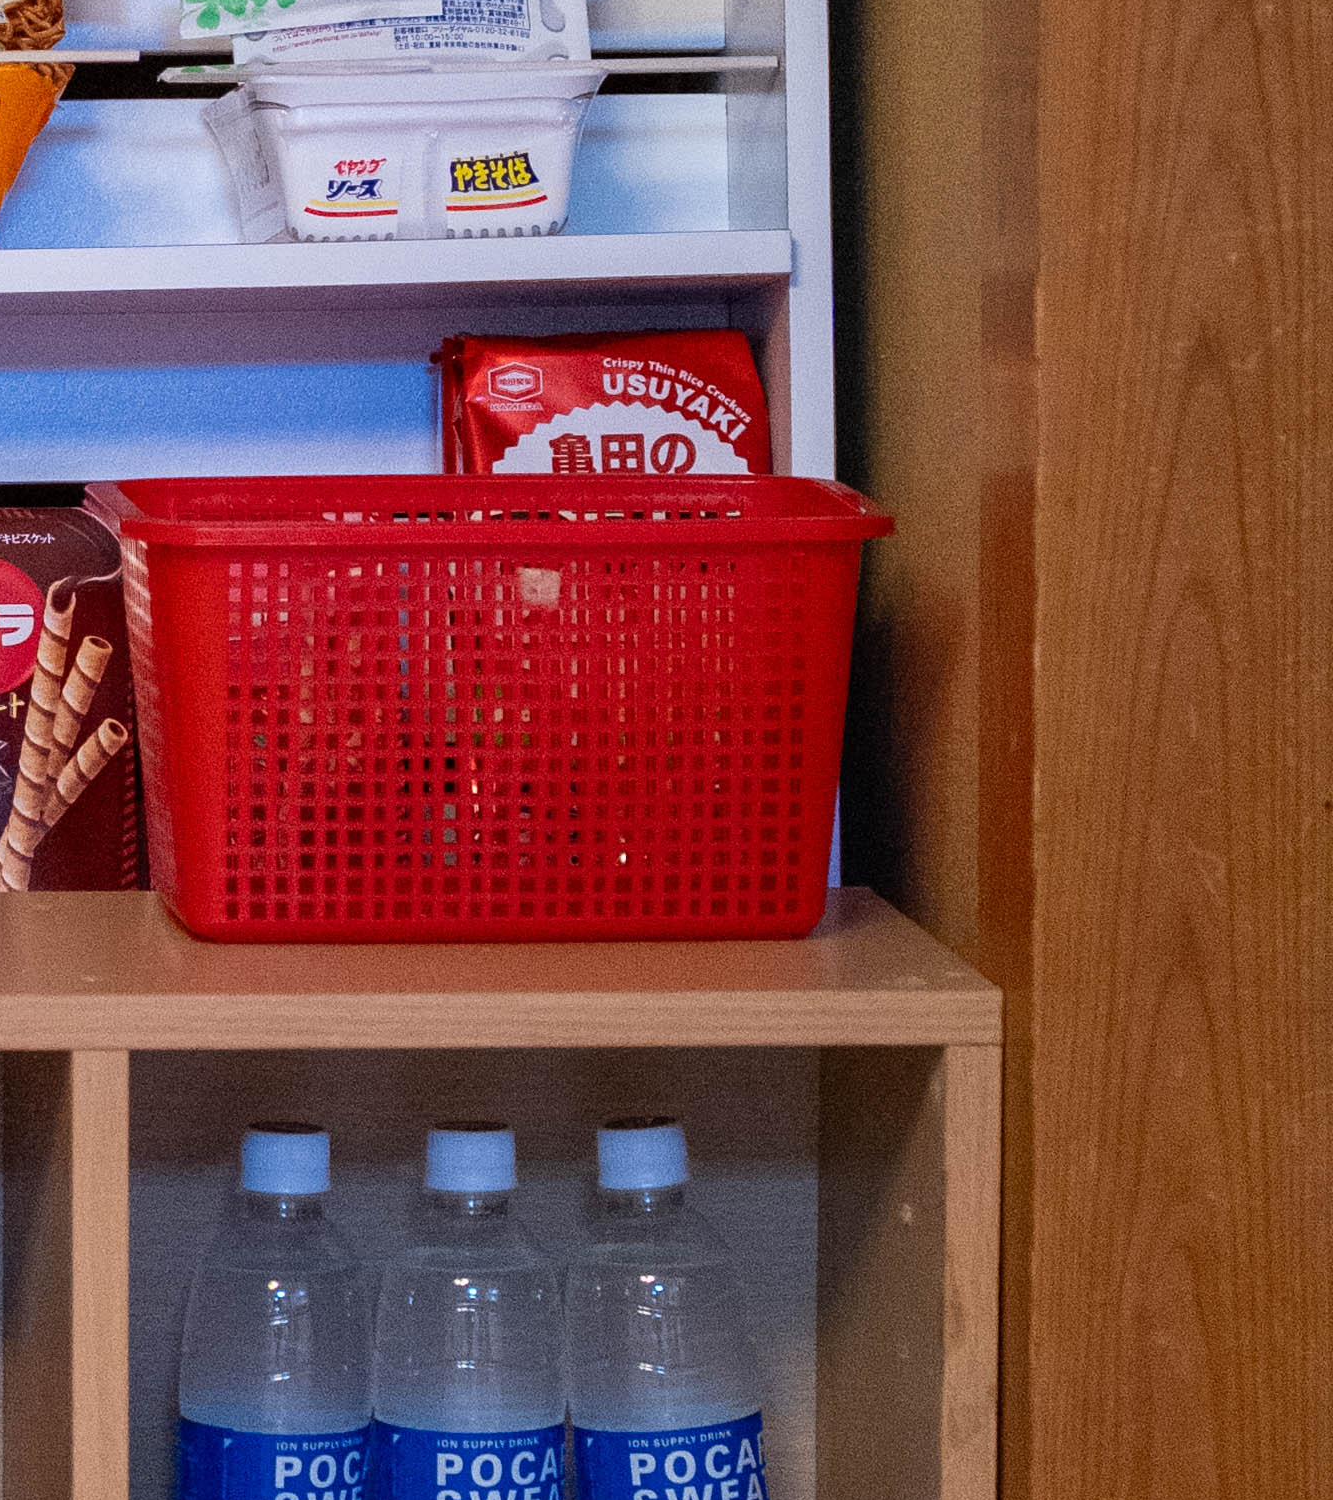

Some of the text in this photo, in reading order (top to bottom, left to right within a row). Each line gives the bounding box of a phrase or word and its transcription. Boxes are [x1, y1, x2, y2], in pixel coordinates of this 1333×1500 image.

[326, 178, 384, 201] ソース
[454, 158, 531, 192] やきそば
[602, 373, 747, 441] USUYAKI
[603, 357, 752, 424] Crispy Thin Rice Crackers
[549, 433, 697, 474] 亀田の
[437, 1438, 504, 1450] ION SUPPLY
[627, 1430, 732, 1449] ION SUPPLY DRINK
